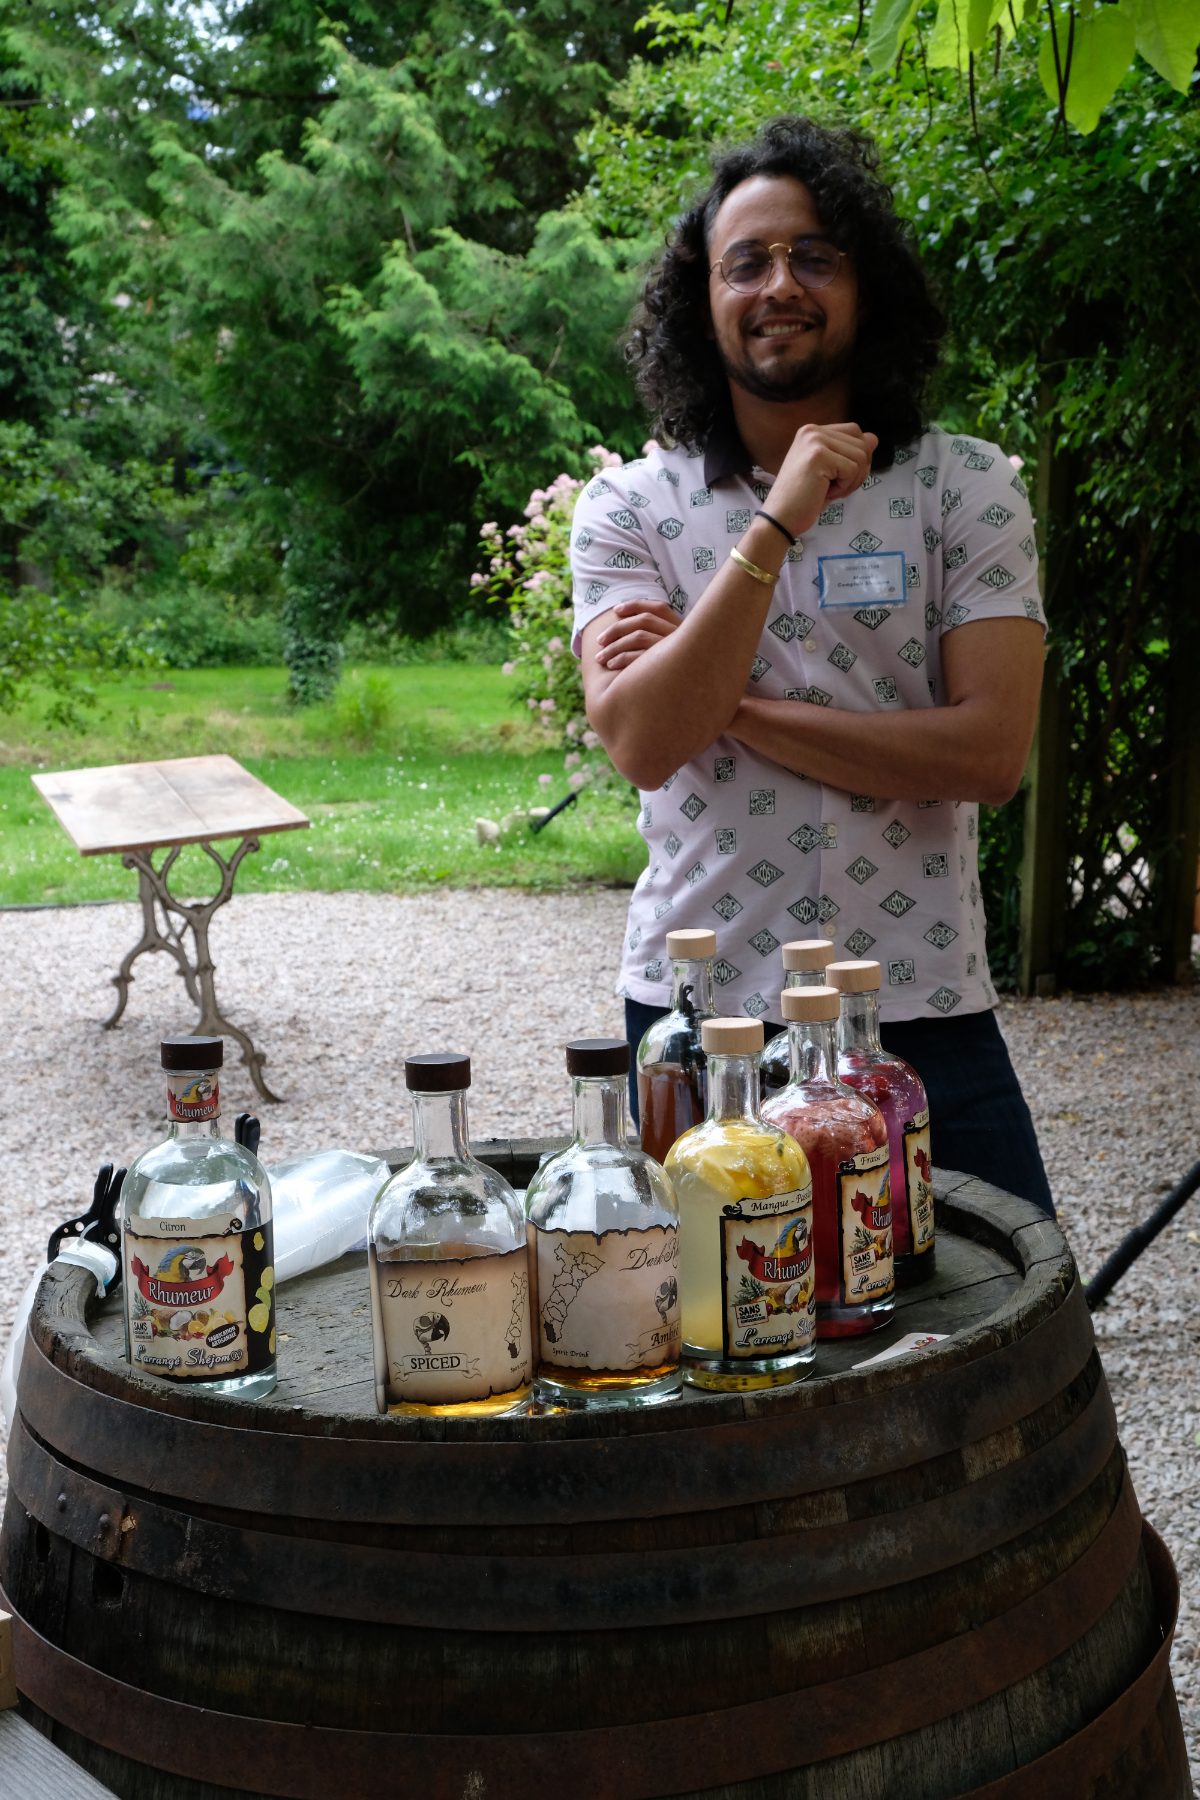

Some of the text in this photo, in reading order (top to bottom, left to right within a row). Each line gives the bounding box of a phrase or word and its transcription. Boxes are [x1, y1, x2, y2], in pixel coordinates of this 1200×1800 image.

[175, 1103, 216, 1118] Rhumeur
[751, 1199, 789, 1213] Mangue
[160, 1221, 187, 1232] Citron
[853, 1251, 871, 1265] SANS
[147, 1281, 215, 1305] Rhumeur
[384, 1277, 487, 1307] Dark Rhumeur
[739, 1303, 761, 1316] SANS
[410, 1356, 460, 1370] SPICED
